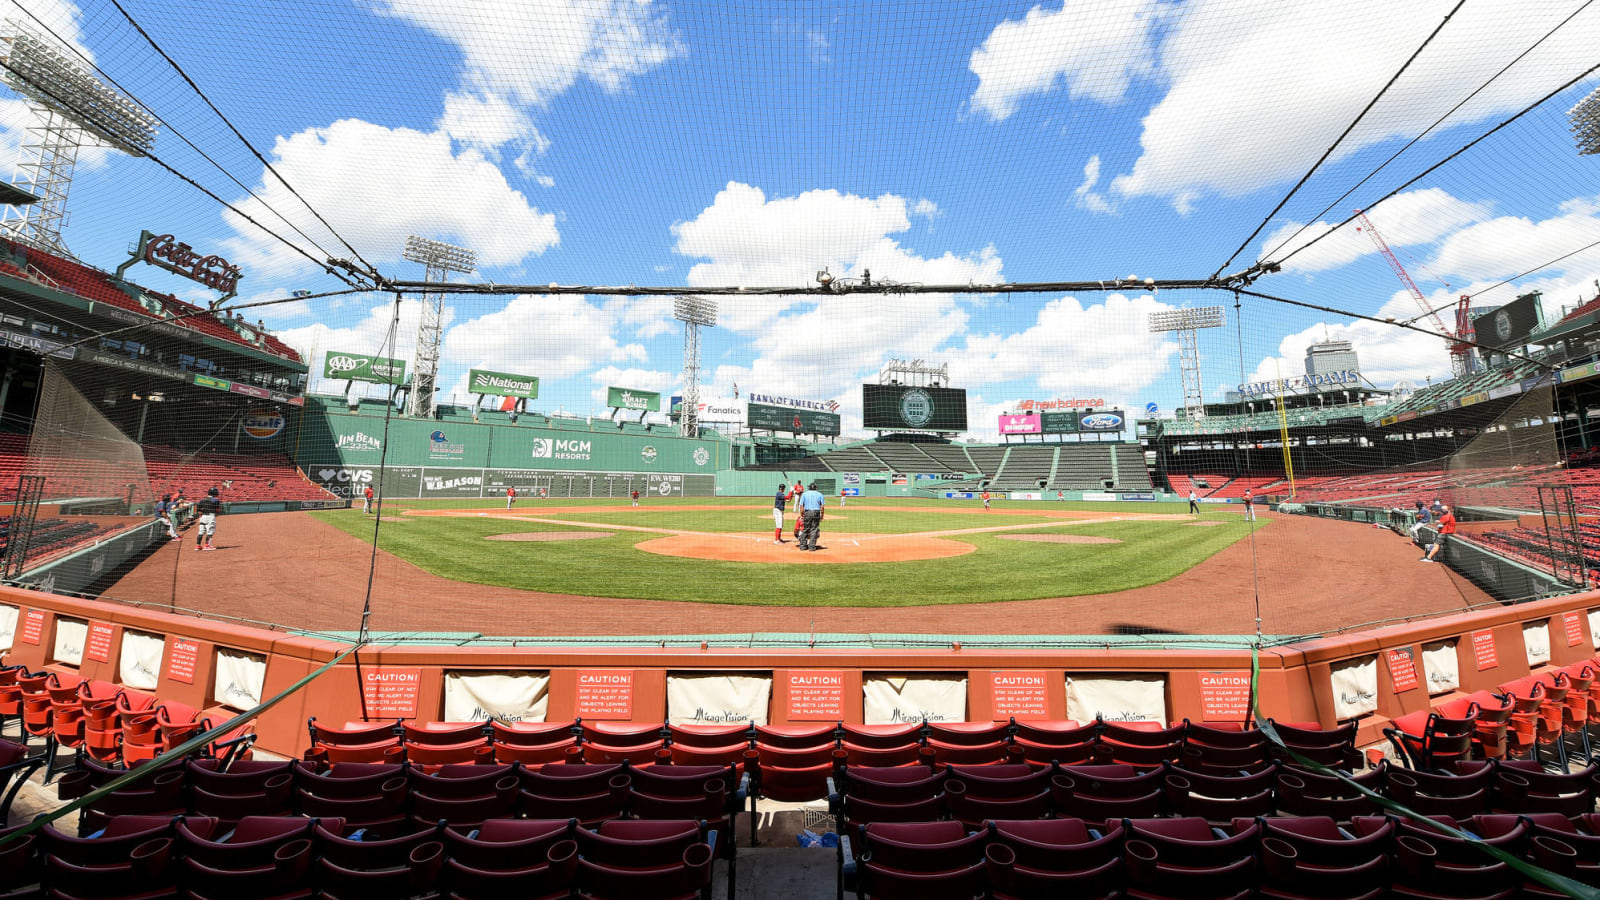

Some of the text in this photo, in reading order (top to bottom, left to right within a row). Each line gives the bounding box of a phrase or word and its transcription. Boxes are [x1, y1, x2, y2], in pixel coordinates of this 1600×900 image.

[146, 234, 241, 292] Coca-Cola
[332, 357, 353, 370] AAA
[488, 376, 533, 390] National
[1301, 369, 1358, 387] ADAMS
[707, 405, 742, 414] Fanatics
[1035, 397, 1104, 410] new balance
[1089, 415, 1114, 425] Ford
[337, 432, 381, 449] JIM BEAM
[555, 439, 591, 452] MGM
[555, 452, 591, 460] RESORTS
[336, 469, 373, 482] CVS
[367, 673, 418, 681] CAUTION!
[580, 675, 631, 683] CAUTION!
[791, 676, 841, 684] CAUTION!
[994, 677, 1044, 685] CAUTION!
